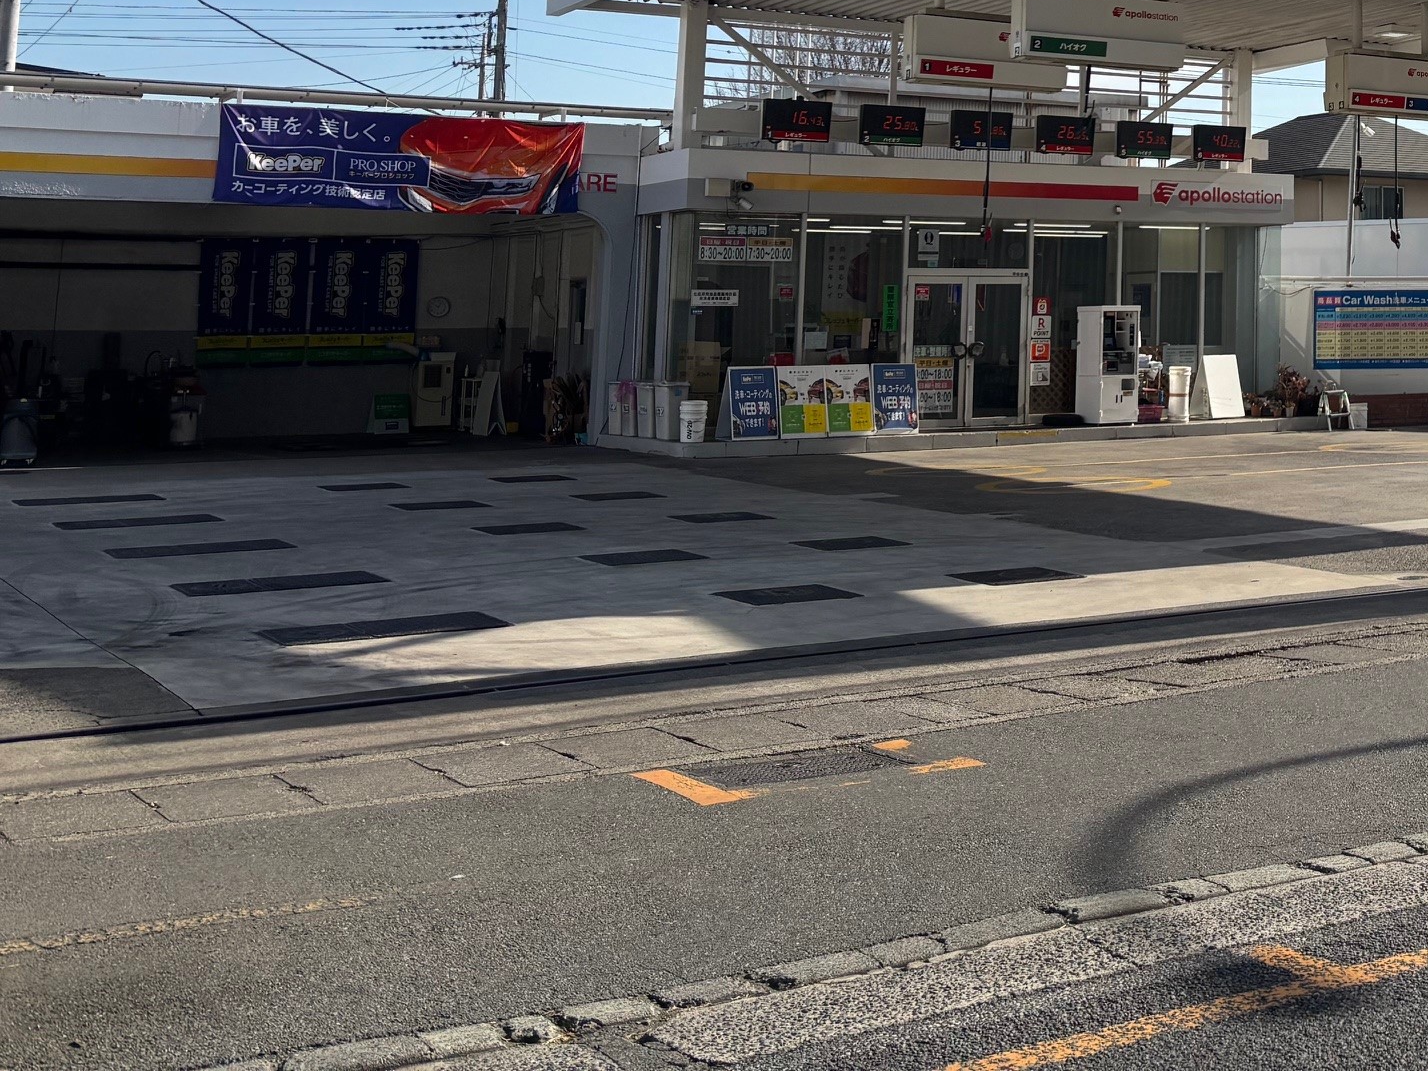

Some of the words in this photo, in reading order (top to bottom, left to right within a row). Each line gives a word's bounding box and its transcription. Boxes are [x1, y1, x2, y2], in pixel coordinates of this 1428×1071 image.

[1125, 10, 1179, 22] apollostation
[1034, 40, 1041, 49] 2
[1059, 42, 1087, 52] ハイオク
[925, 63, 930, 71] 1
[946, 64, 978, 74] レギュラー
[1370, 97, 1394, 105] レギュラー
[235, 114, 392, 143] お車を、美しく。
[864, 135, 870, 143] 2
[247, 152, 325, 174] KeePer
[350, 158, 378, 171] PRO
[380, 160, 416, 172] SHOP
[1178, 186, 1283, 206] apollostation
[726, 225, 768, 235] 営業時間
[700, 247, 745, 259] 8:30~20:00
[748, 247, 791, 260] 7:30~20:00
[219, 251, 241, 318] KeePer
[274, 251, 297, 318] KeePer
[331, 251, 355, 318] KeePer
[385, 251, 408, 318] KeePer
[1342, 295, 1361, 305] Car
[1363, 295, 1393, 305] Wash
[1037, 317, 1045, 328] R
[916, 368, 952, 380] :00~18:00
